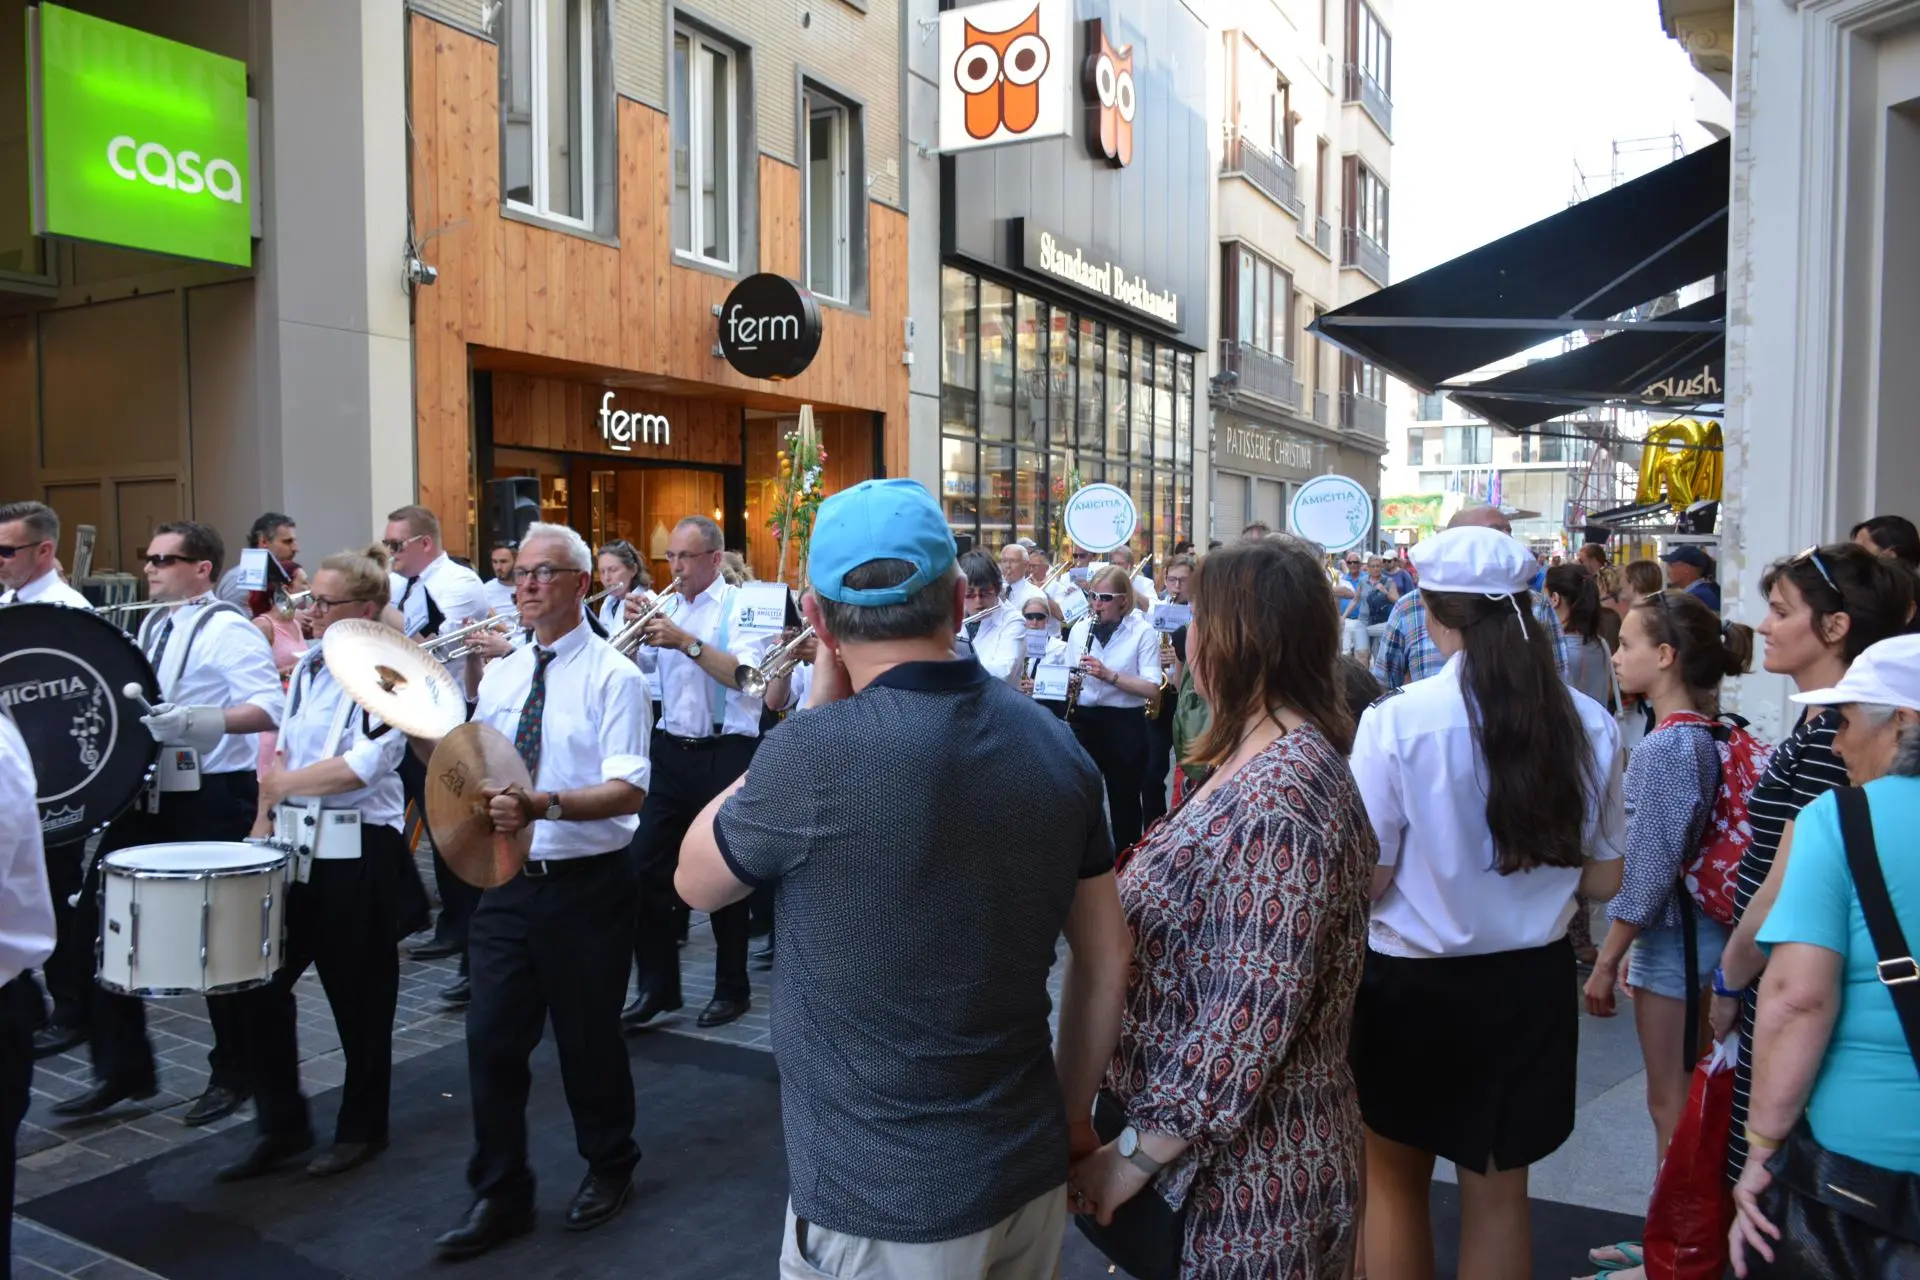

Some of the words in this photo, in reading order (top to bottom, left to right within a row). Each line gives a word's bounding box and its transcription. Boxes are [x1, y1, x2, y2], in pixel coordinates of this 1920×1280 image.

[107, 135, 242, 203] casa
[1040, 231, 1111, 296] Standaard
[1113, 265, 1177, 324] Boekhandel
[727, 304, 799, 350] ferm
[599, 391, 670, 451] ferm
[1226, 426, 1271, 462] PATISSERIE
[1274, 439, 1312, 471] CHRISTINA
[1074, 499, 1121, 511] AMICITIA
[1302, 491, 1355, 505] AMICITIA
